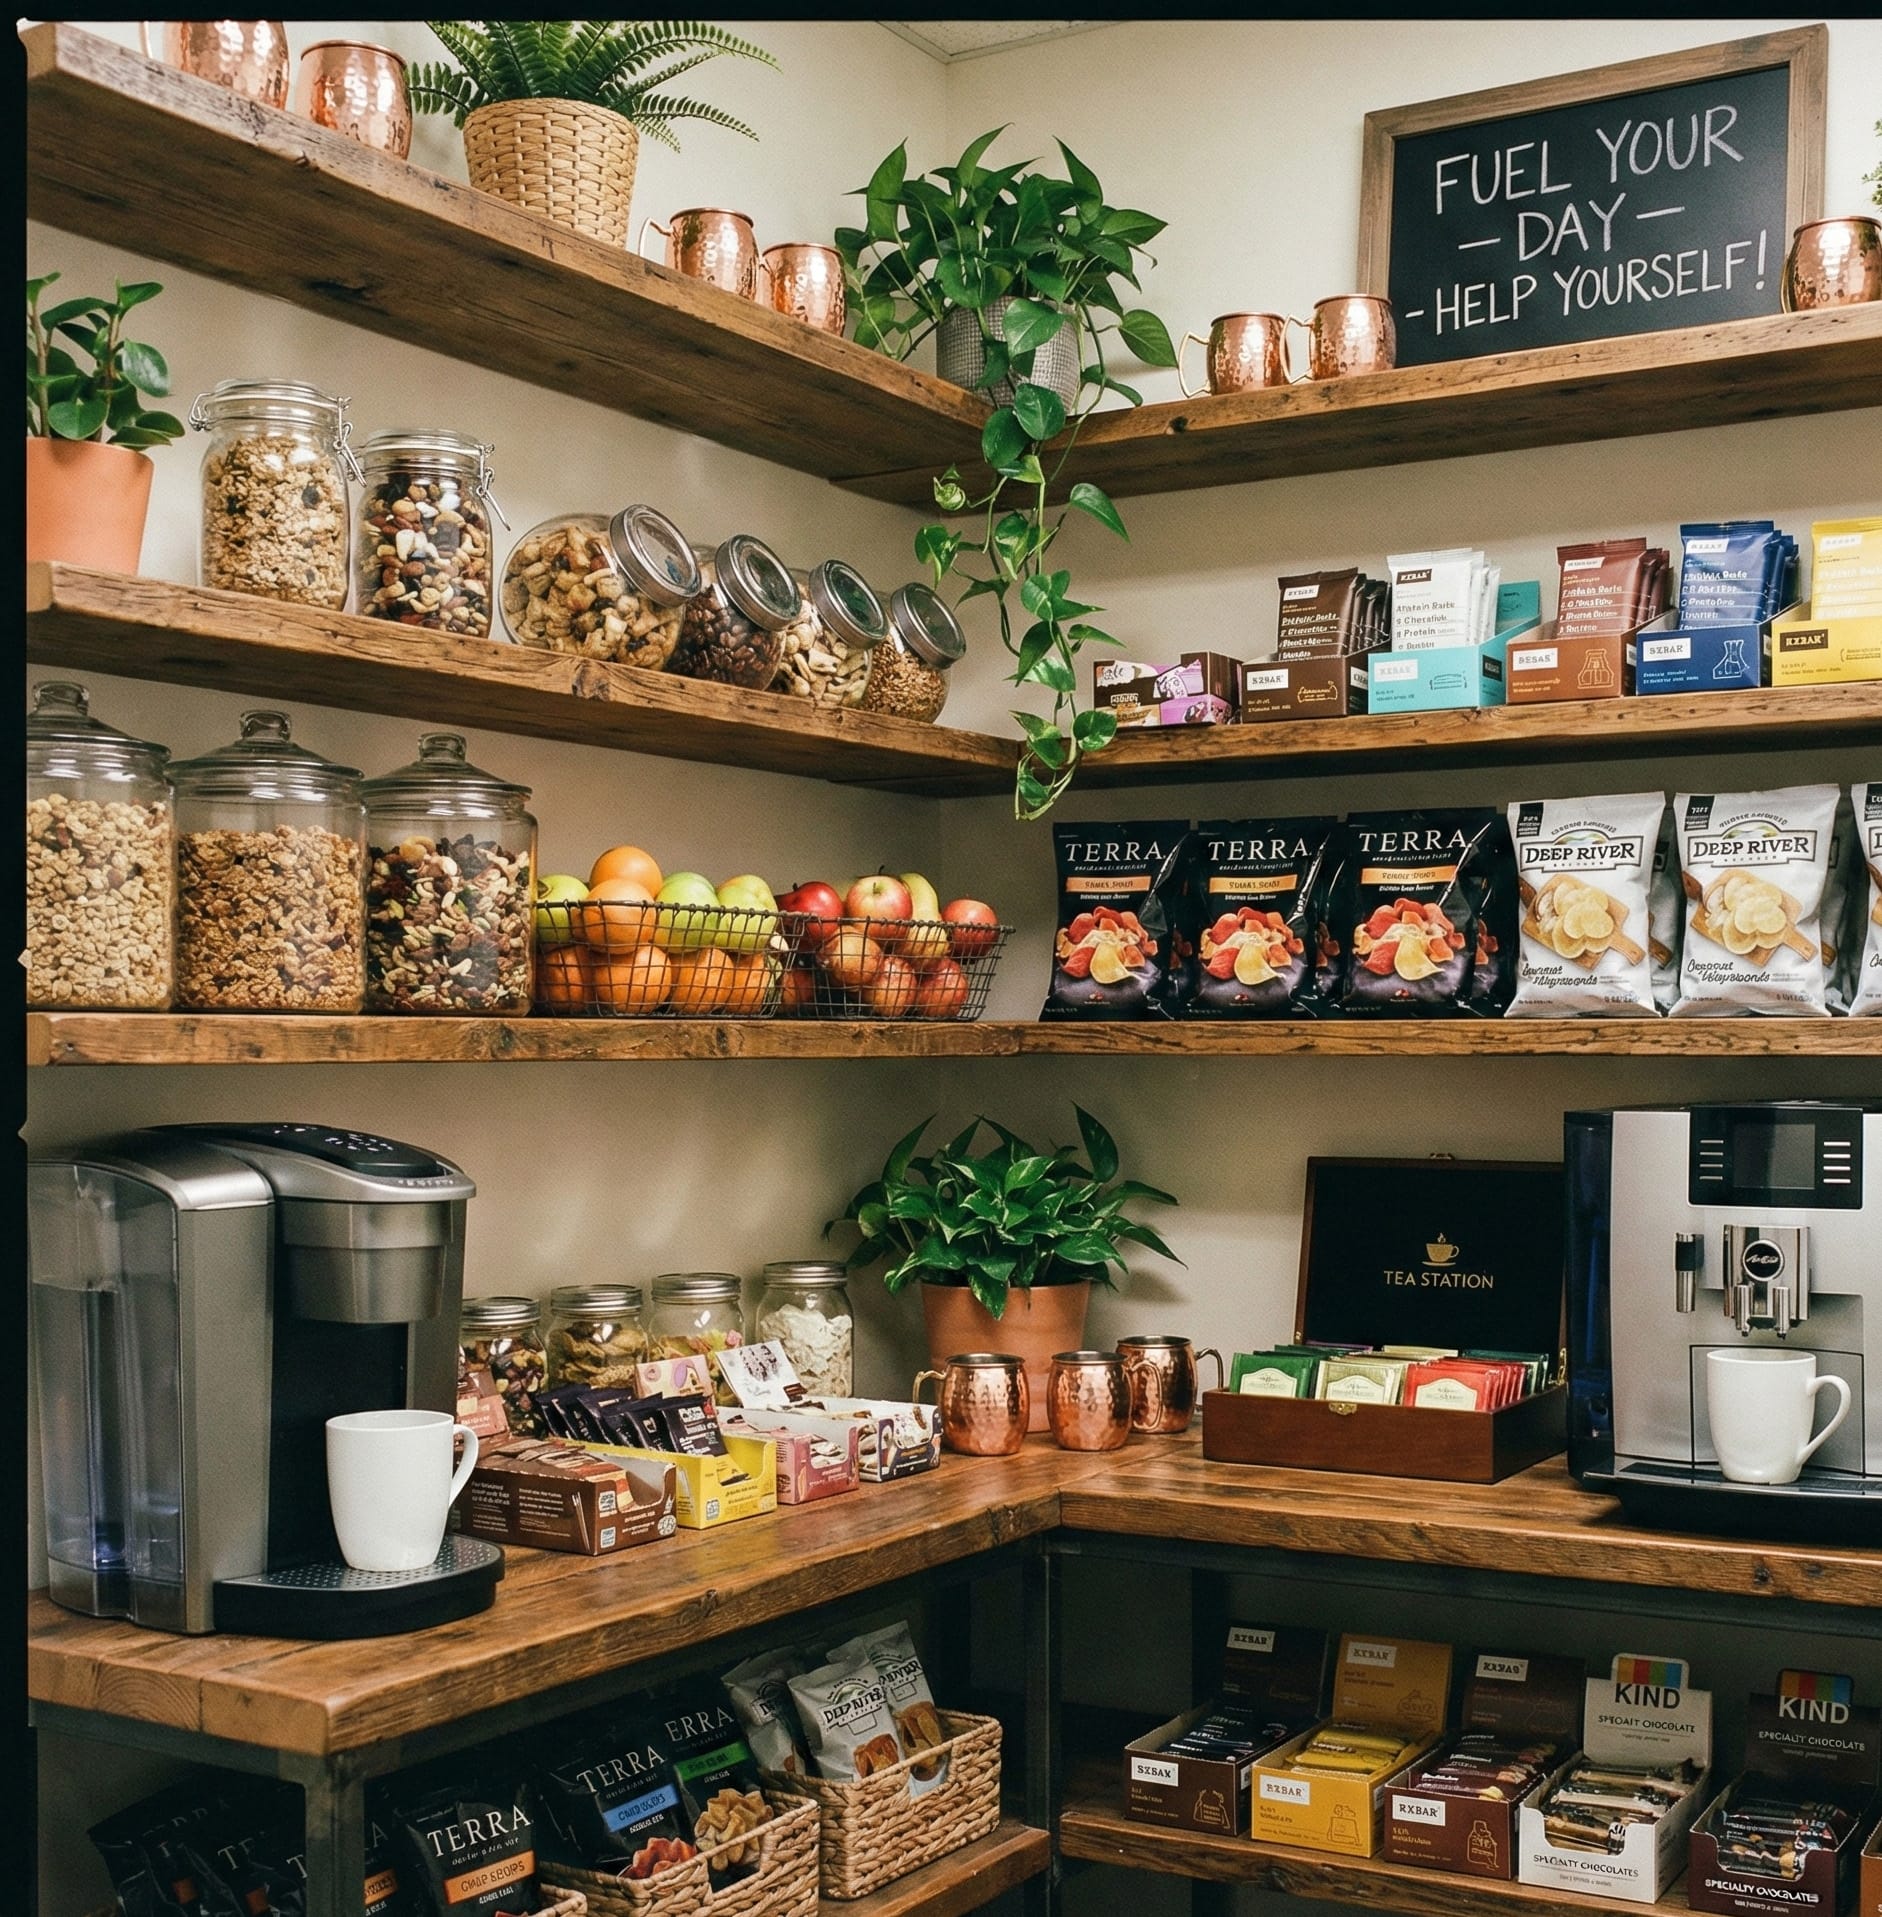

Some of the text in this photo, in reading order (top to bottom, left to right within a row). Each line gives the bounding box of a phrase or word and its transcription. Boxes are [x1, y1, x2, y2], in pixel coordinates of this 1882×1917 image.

[1436, 104, 1745, 215] FUEL YOUR
[1517, 192, 1627, 262] DAY
[1552, 229, 1768, 316] YOURSELF!
[1065, 841, 1164, 862] TERRA
[1208, 837, 1309, 861] TERRA
[1358, 829, 1467, 852] TERRA
[1693, 836, 1810, 857] DEEP RIVER
[1525, 843, 1635, 864] DEEP RIVER
[1383, 1270, 1494, 1289] TEA STATION
[1615, 1683, 1681, 1709] KIND
[1779, 1695, 1850, 1724] KIND
[576, 1744, 666, 1793] TERRA
[1399, 1803, 1438, 1818] RXBAR
[426, 1803, 532, 1857] TERRA
